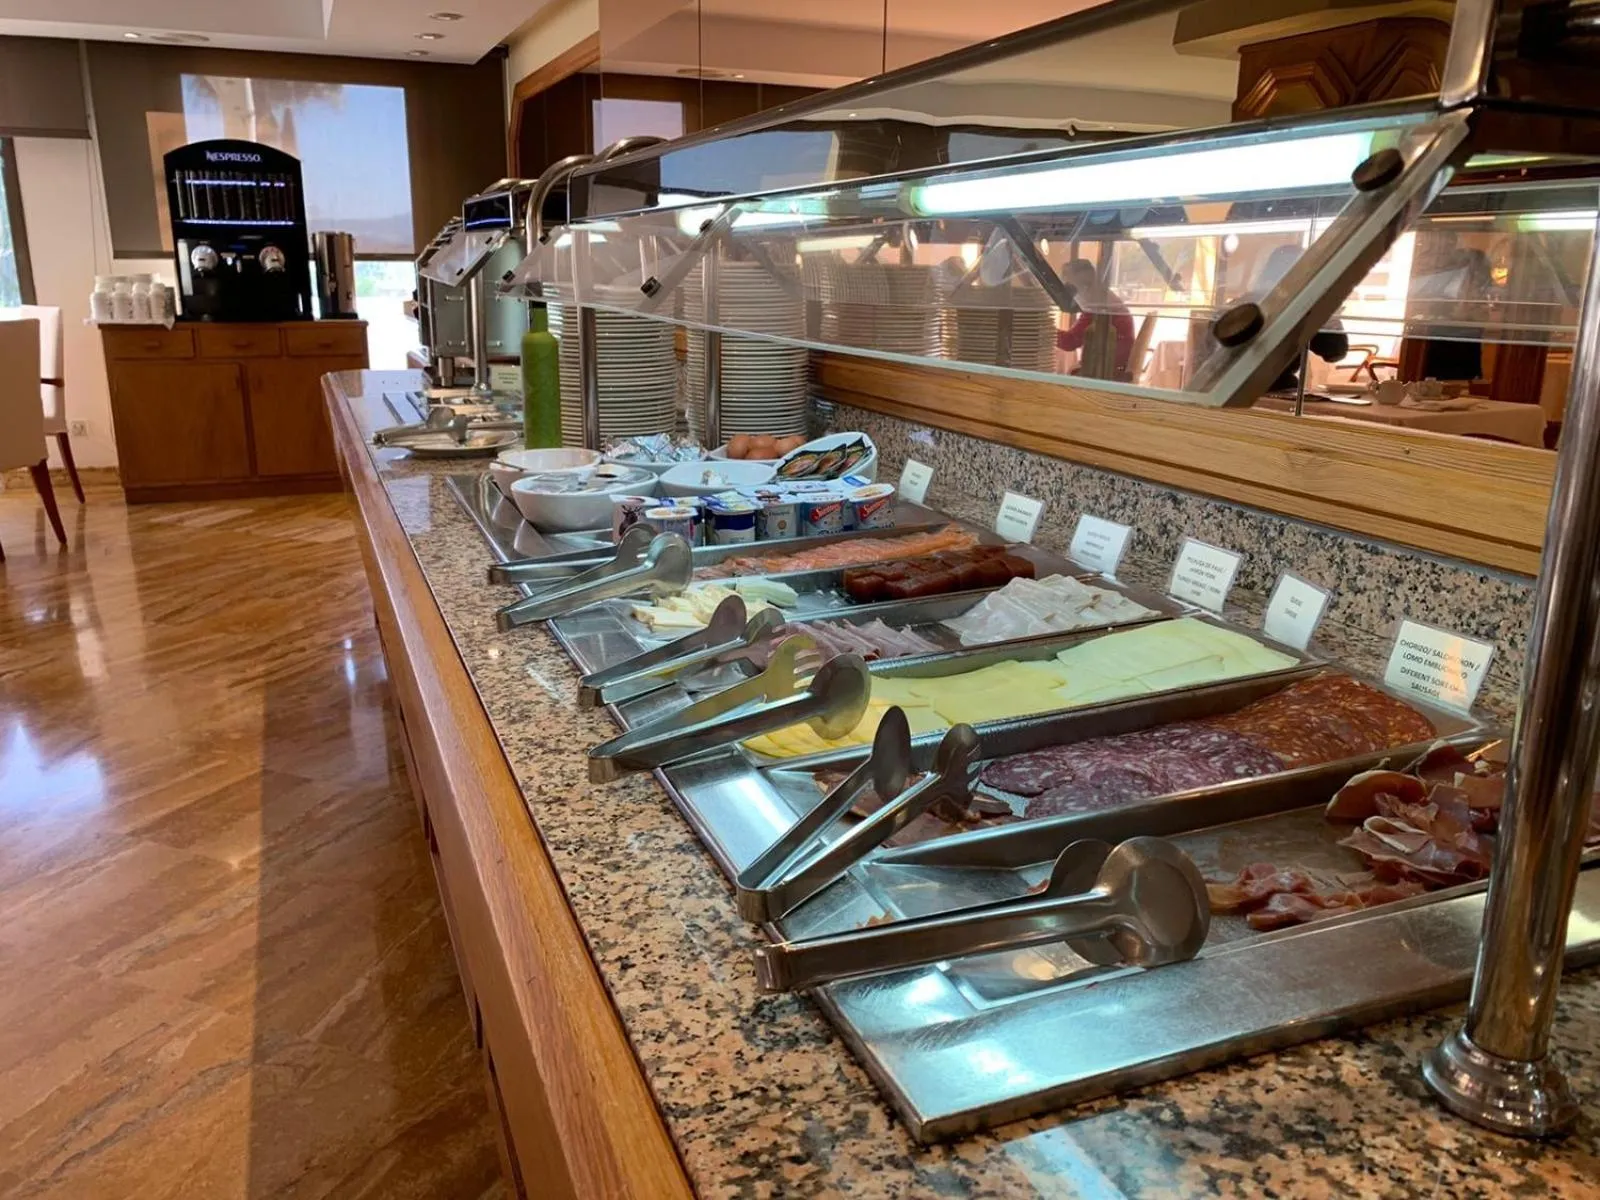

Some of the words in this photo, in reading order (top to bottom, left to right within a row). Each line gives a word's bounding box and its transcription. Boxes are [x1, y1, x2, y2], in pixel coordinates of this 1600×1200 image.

[205, 150, 261, 162] NESPRESSO
[1402, 652, 1424, 664] LOMO
[1400, 666, 1430, 681] DIFERENT
